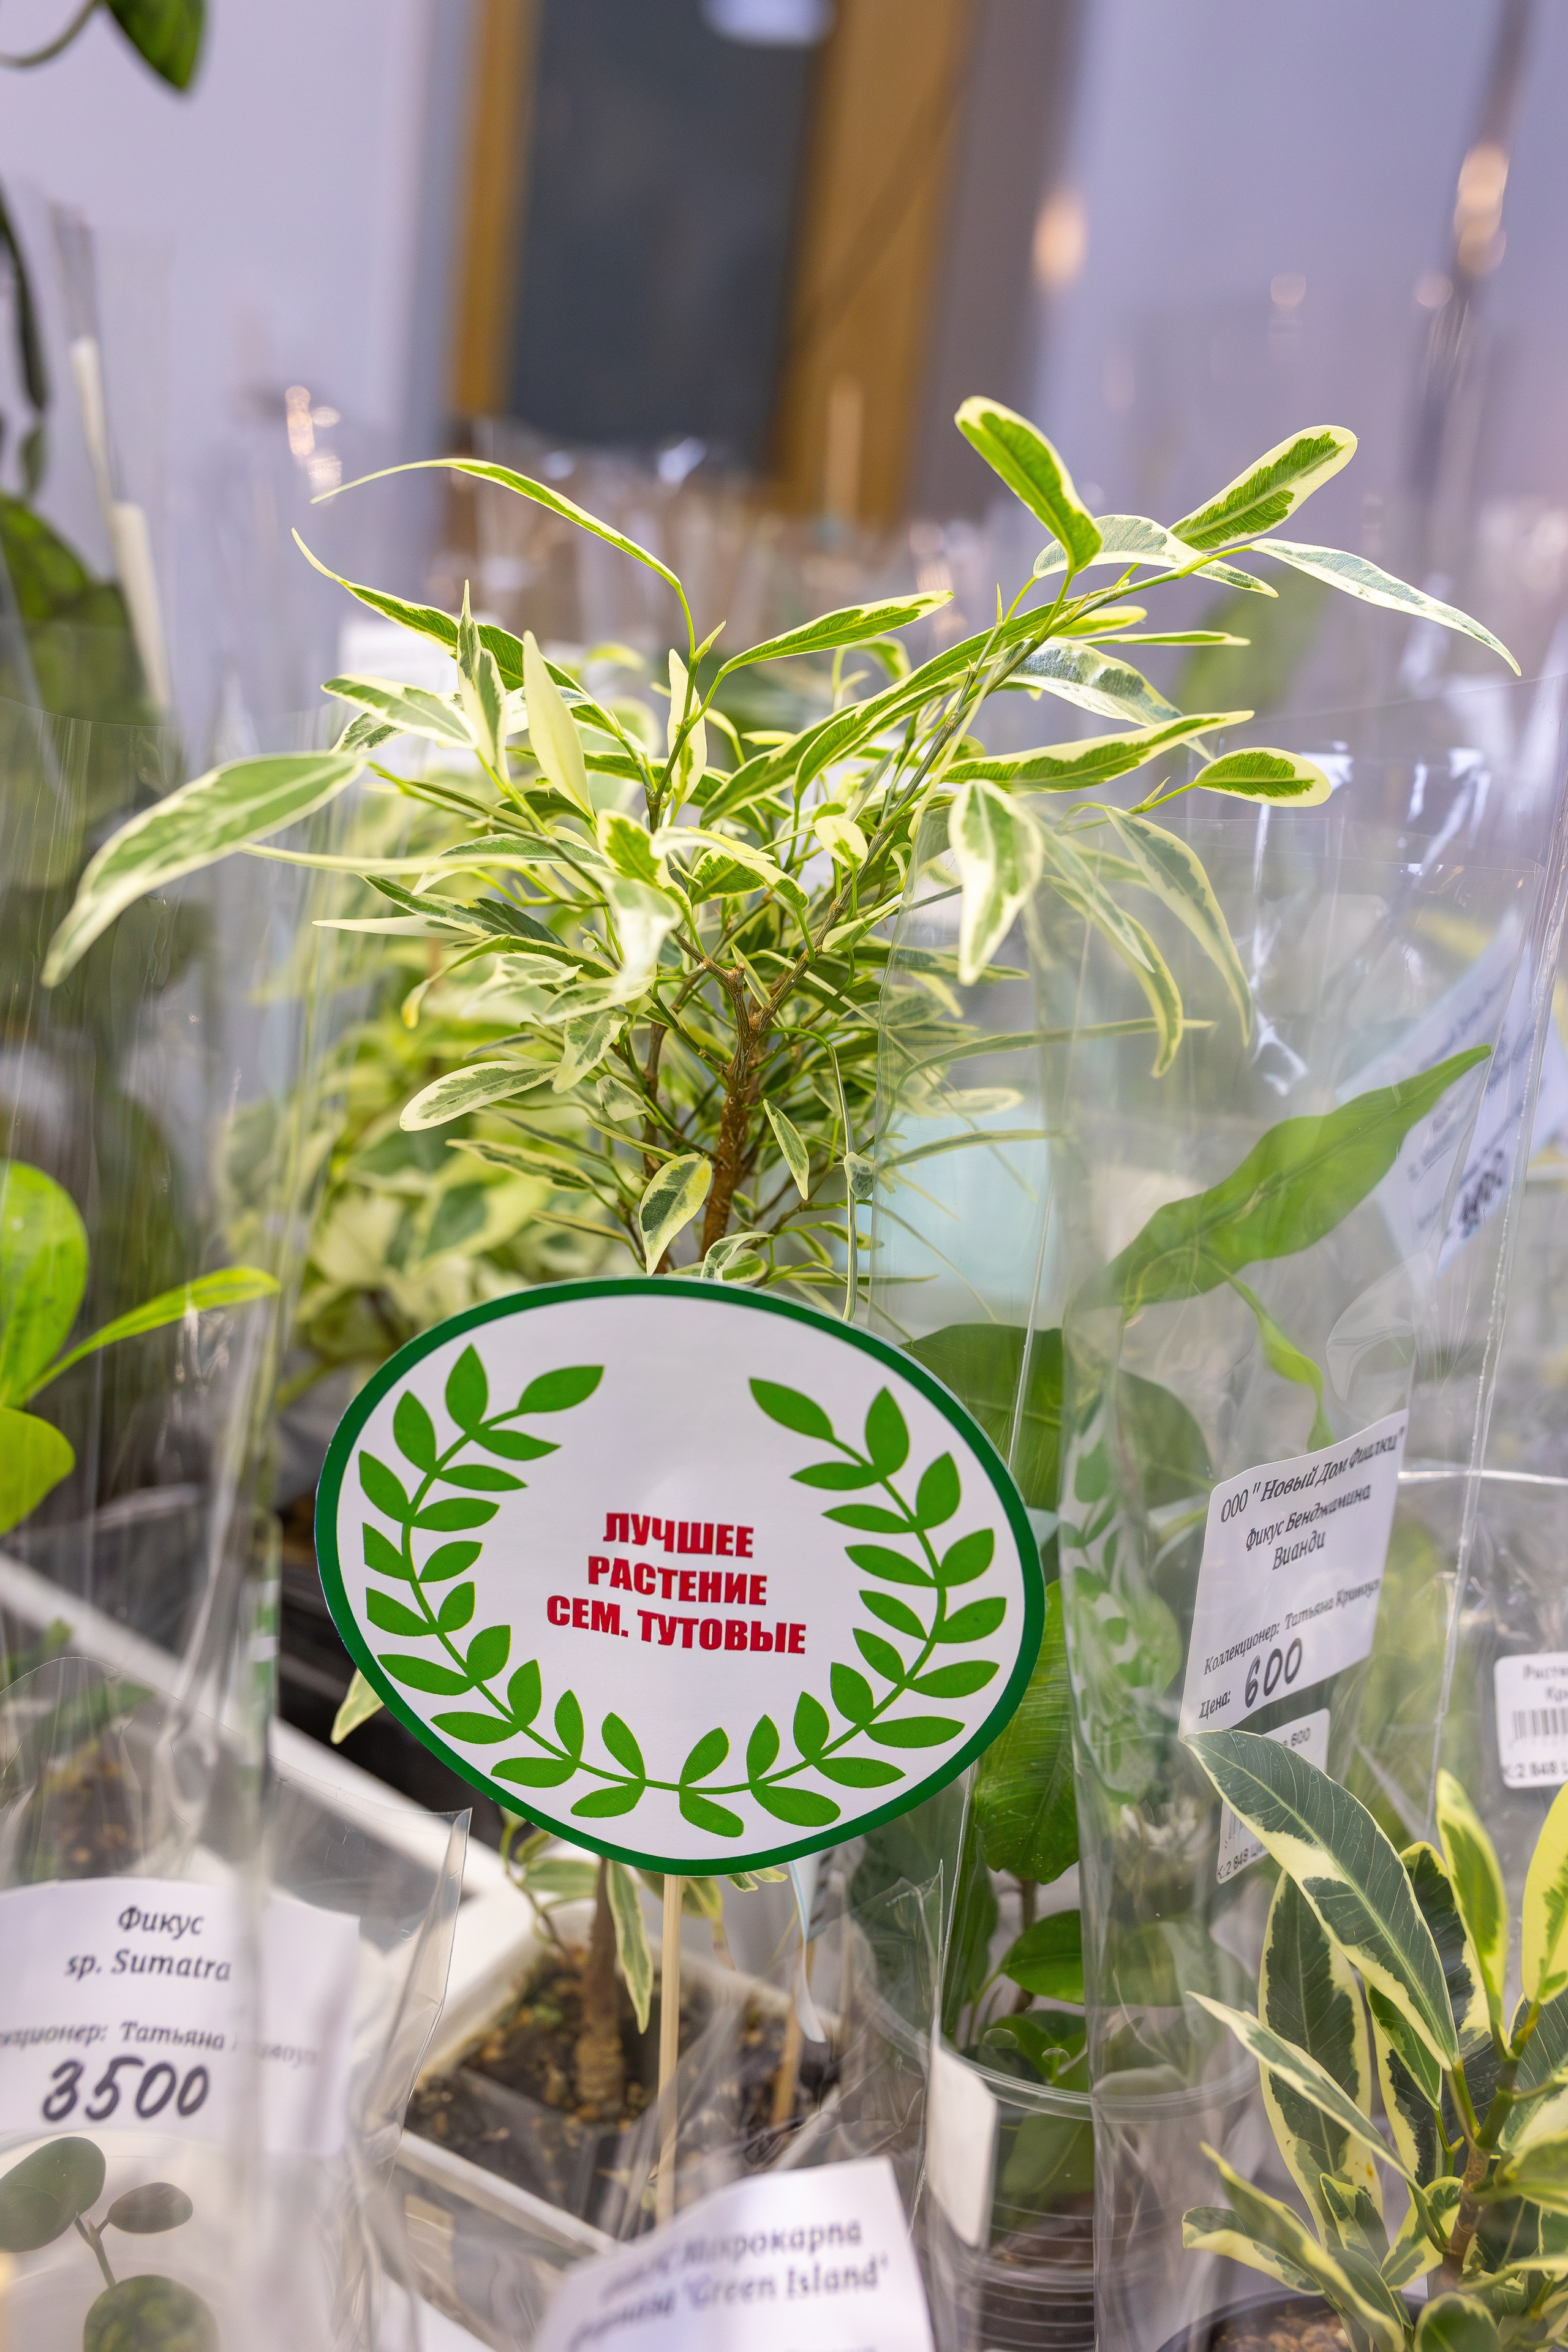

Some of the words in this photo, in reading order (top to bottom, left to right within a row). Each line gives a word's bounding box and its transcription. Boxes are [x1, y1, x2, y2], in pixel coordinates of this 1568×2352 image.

[1314, 1457, 1349, 1488] Дом
[603, 1512, 754, 1558] ЛУЧШЕЕ
[1246, 1519, 1284, 1552] Фикус
[1272, 1529, 1325, 1570] Вианди
[588, 1556, 767, 1605] РАСТЕНИЕ
[546, 1595, 629, 1637] СЕМ.
[637, 1609, 807, 1654] ТУТОВЫЕ
[1203, 1623, 1280, 1676] Коллекционер:
[1198, 1690, 1231, 1719] Цена:
[1245, 1637, 1303, 1709] 600
[118, 1905, 205, 1940] Фикус
[64, 1953, 102, 1981] sp.
[110, 1948, 232, 1981] Sumatra
[120, 2020, 225, 2052] Татьяна
[41, 2055, 211, 2122] 3500
